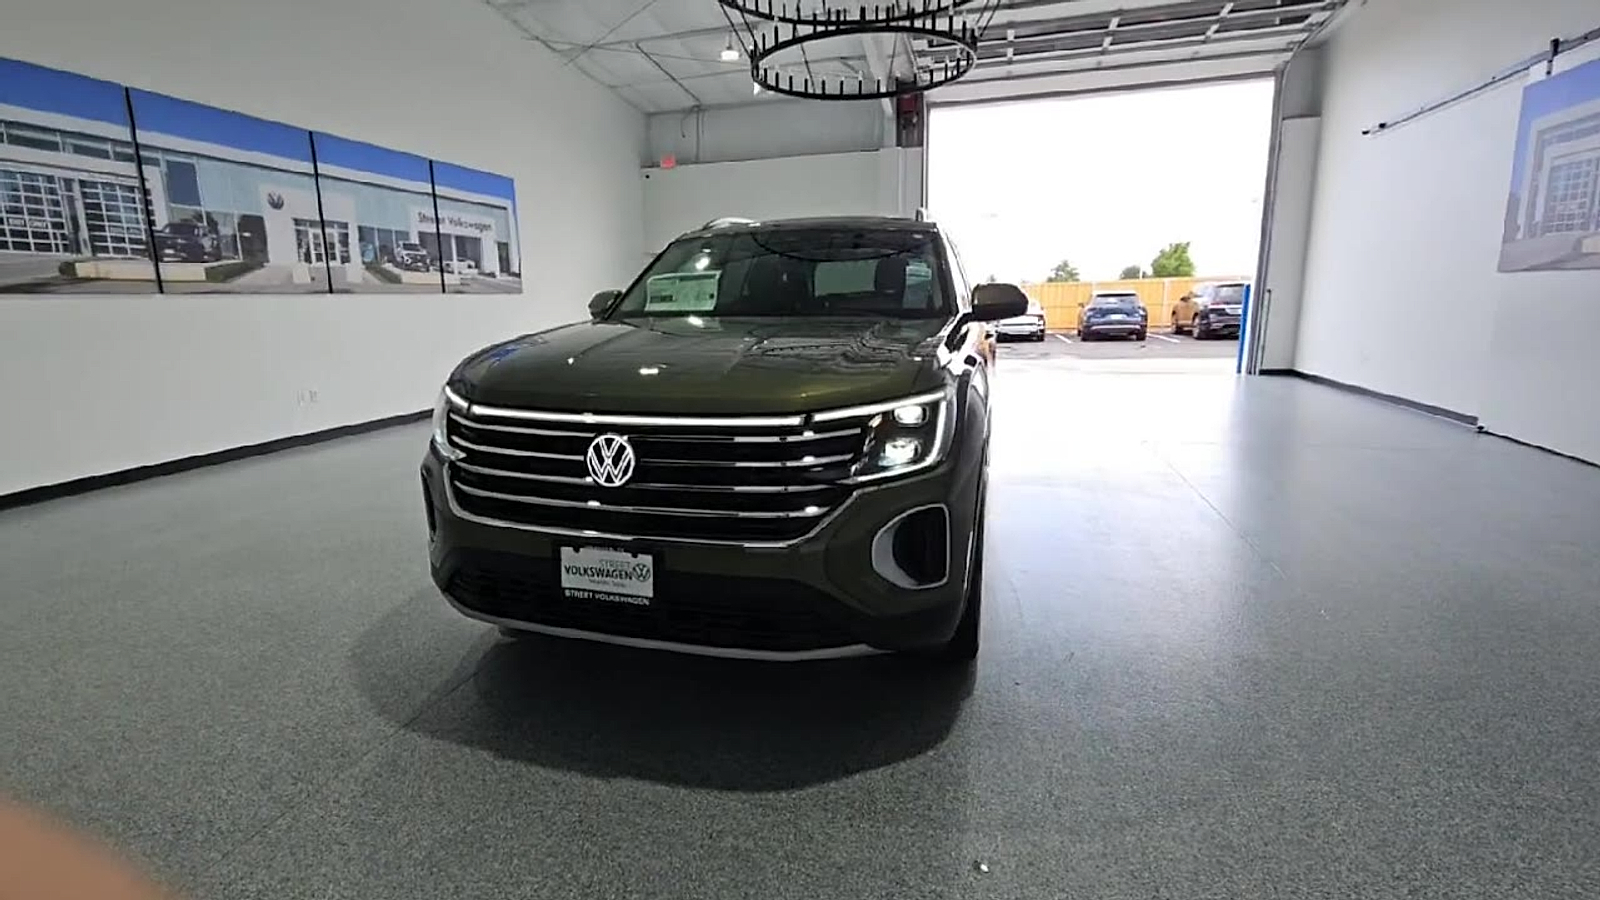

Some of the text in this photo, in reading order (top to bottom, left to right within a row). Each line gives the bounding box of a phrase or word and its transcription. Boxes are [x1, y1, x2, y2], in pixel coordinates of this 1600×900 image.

[586, 434, 635, 487] VW
[600, 559, 631, 570] STREET
[564, 565, 633, 581] VOLKSWAGEN
[564, 589, 650, 606] STREET VOLKSWAGEN
